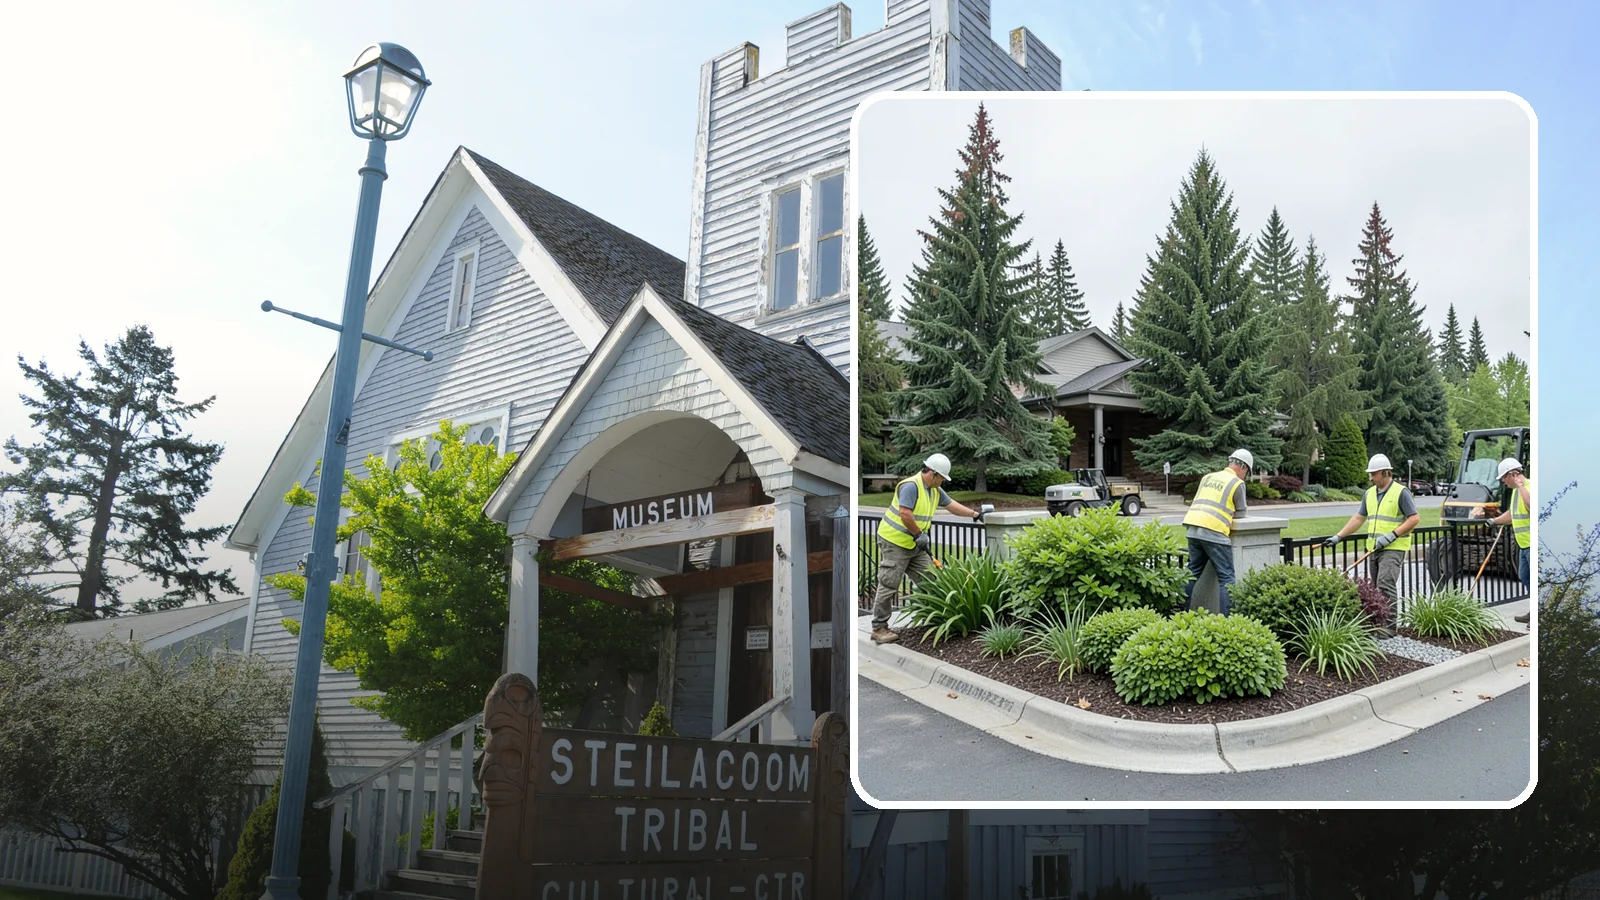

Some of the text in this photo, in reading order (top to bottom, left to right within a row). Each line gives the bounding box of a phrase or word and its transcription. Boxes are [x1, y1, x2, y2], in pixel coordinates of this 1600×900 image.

[613, 492, 713, 530] MUSEUM
[551, 739, 809, 792] STEILACOOM
[615, 807, 757, 851] TRIBAL
